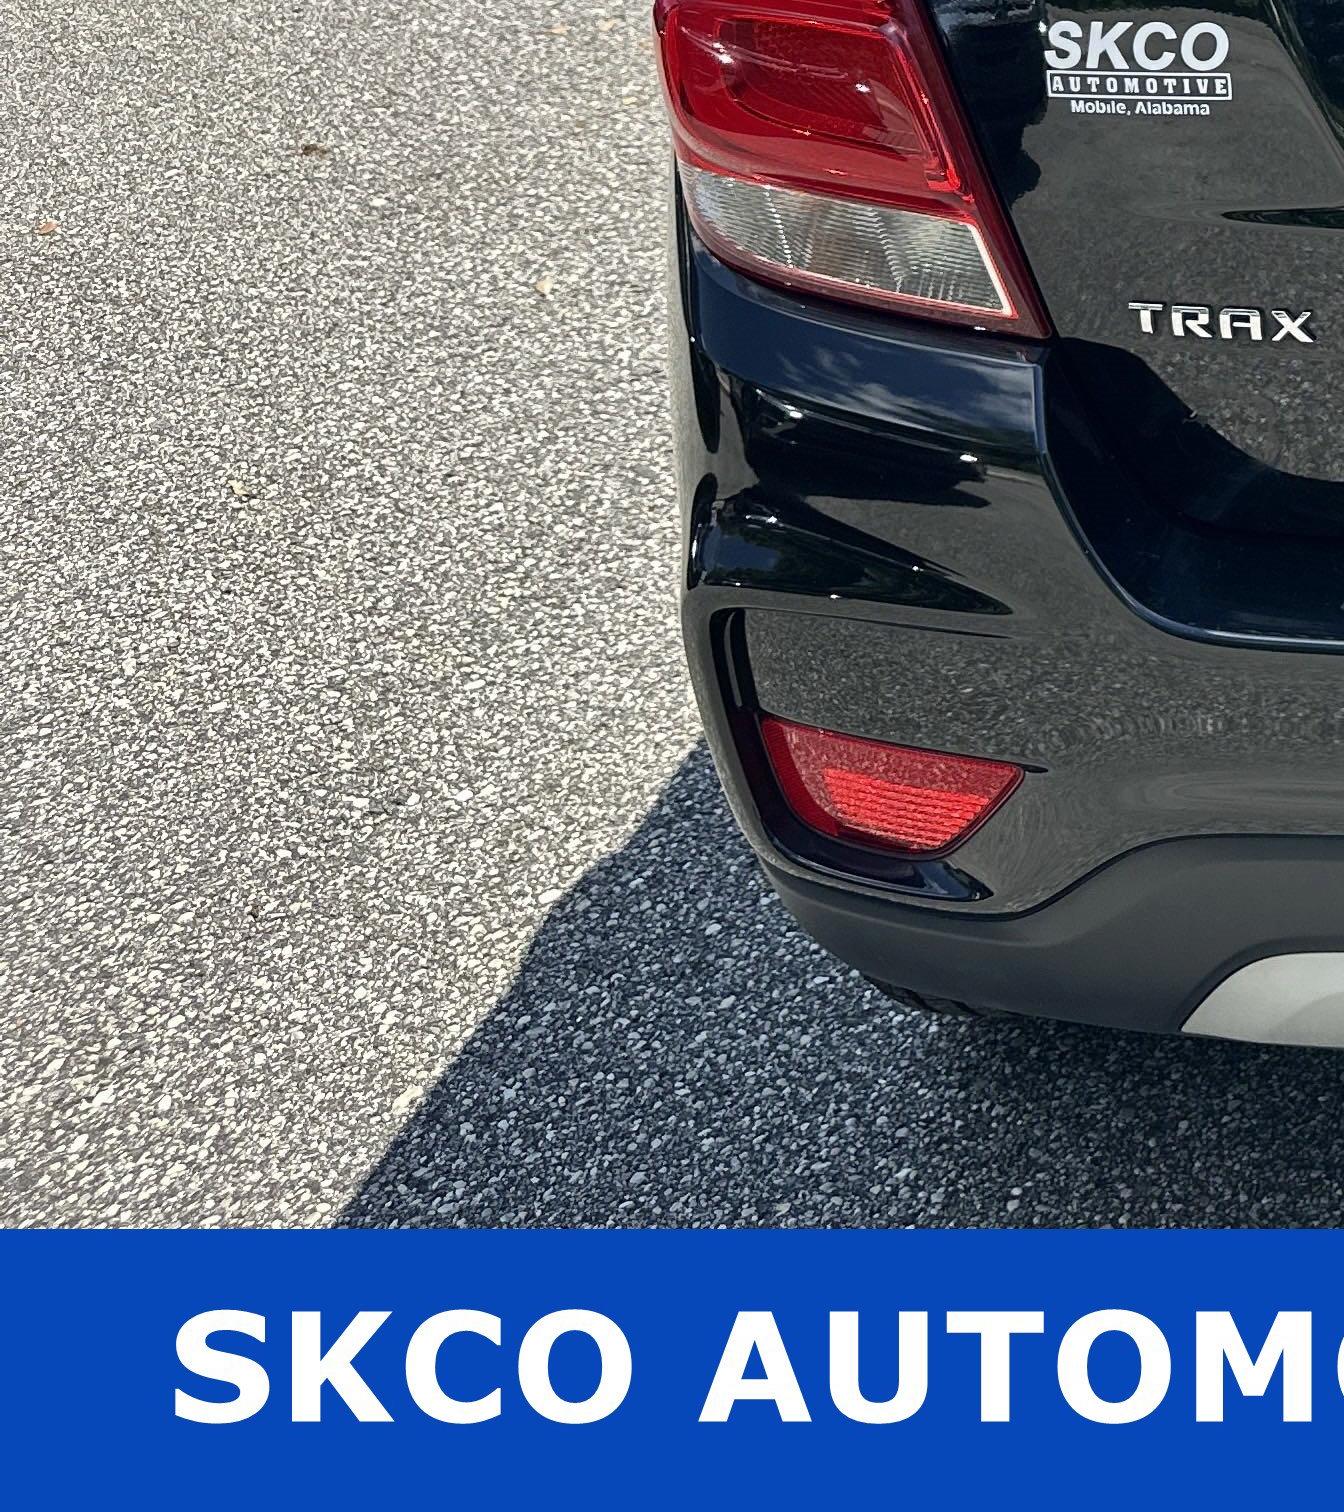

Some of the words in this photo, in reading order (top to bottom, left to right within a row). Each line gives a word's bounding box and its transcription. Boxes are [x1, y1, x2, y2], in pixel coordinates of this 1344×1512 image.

[1044, 20, 1230, 71] SKCO
[1052, 75, 1227, 94] AUTOMOTIVE
[1071, 100, 1131, 116] Mobile,
[1134, 100, 1210, 115] Alabama
[1128, 302, 1314, 343] TRAX
